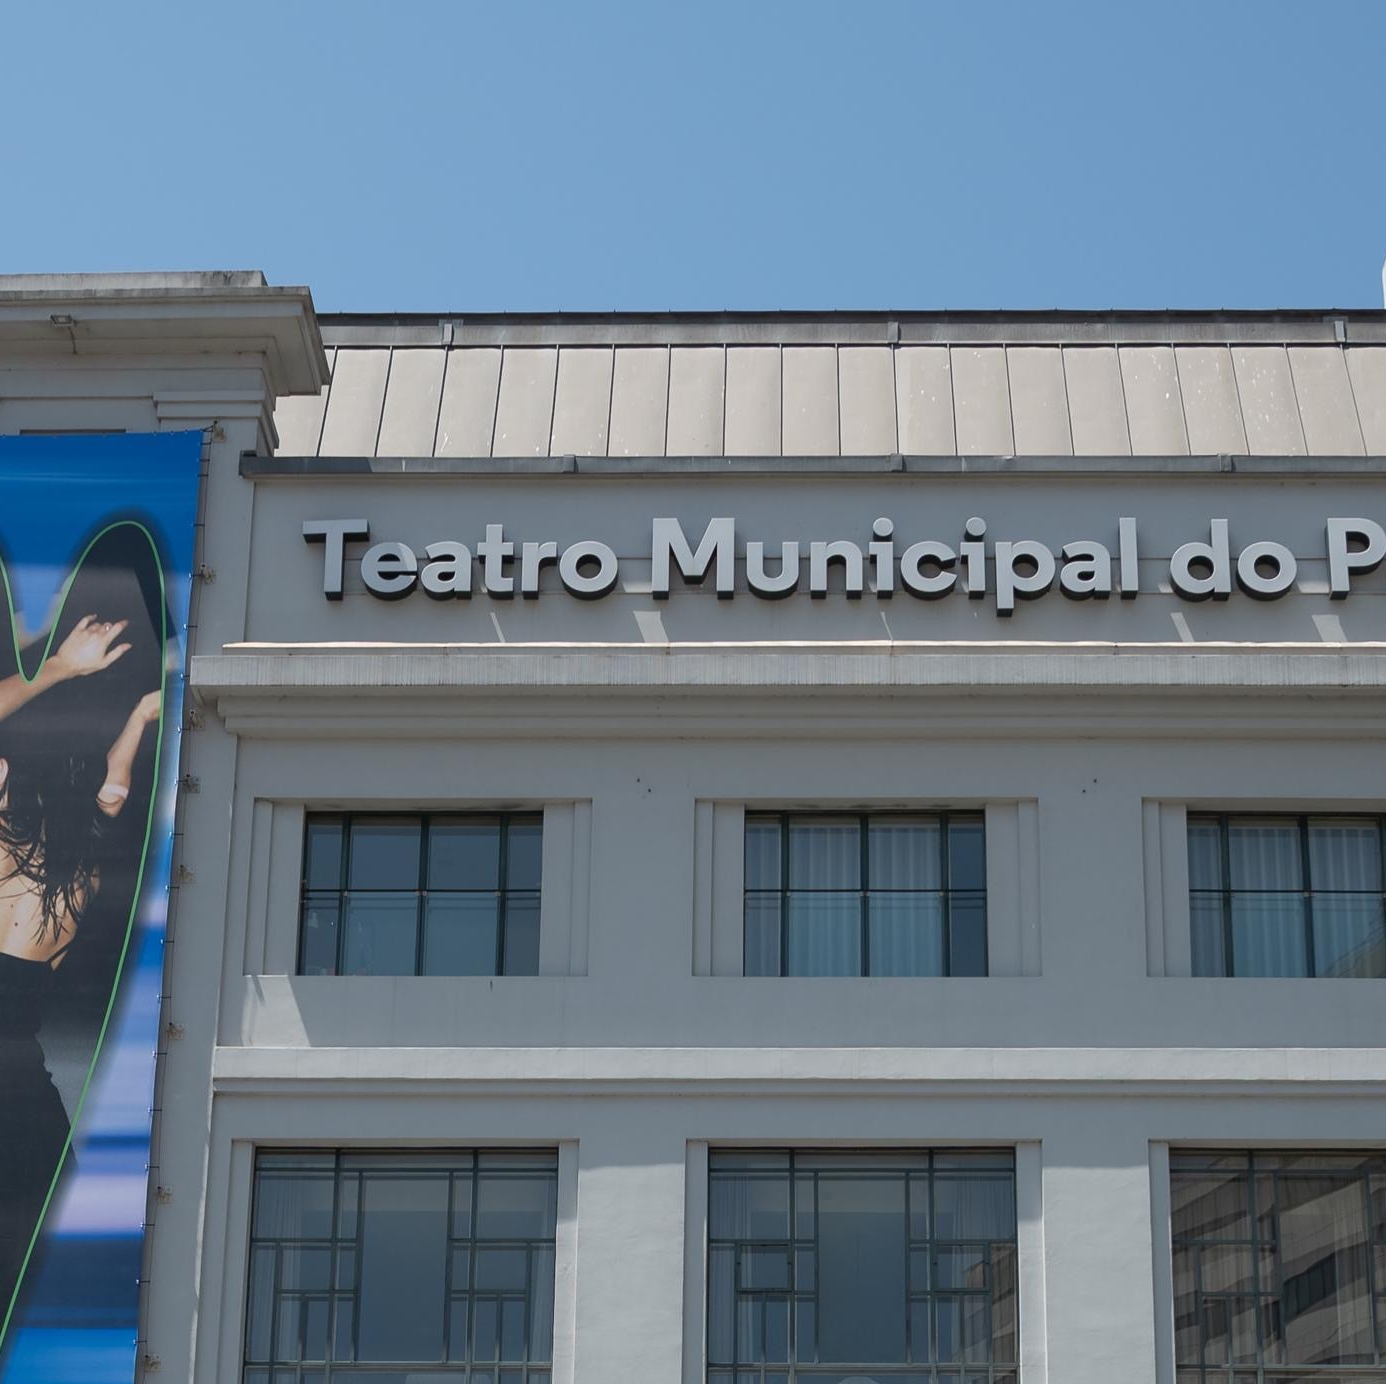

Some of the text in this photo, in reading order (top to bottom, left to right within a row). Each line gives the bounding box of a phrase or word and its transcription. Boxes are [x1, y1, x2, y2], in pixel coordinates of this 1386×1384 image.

[303, 519, 618, 600] Teatro
[652, 517, 1137, 617] Municipal
[1170, 518, 1297, 601] do
